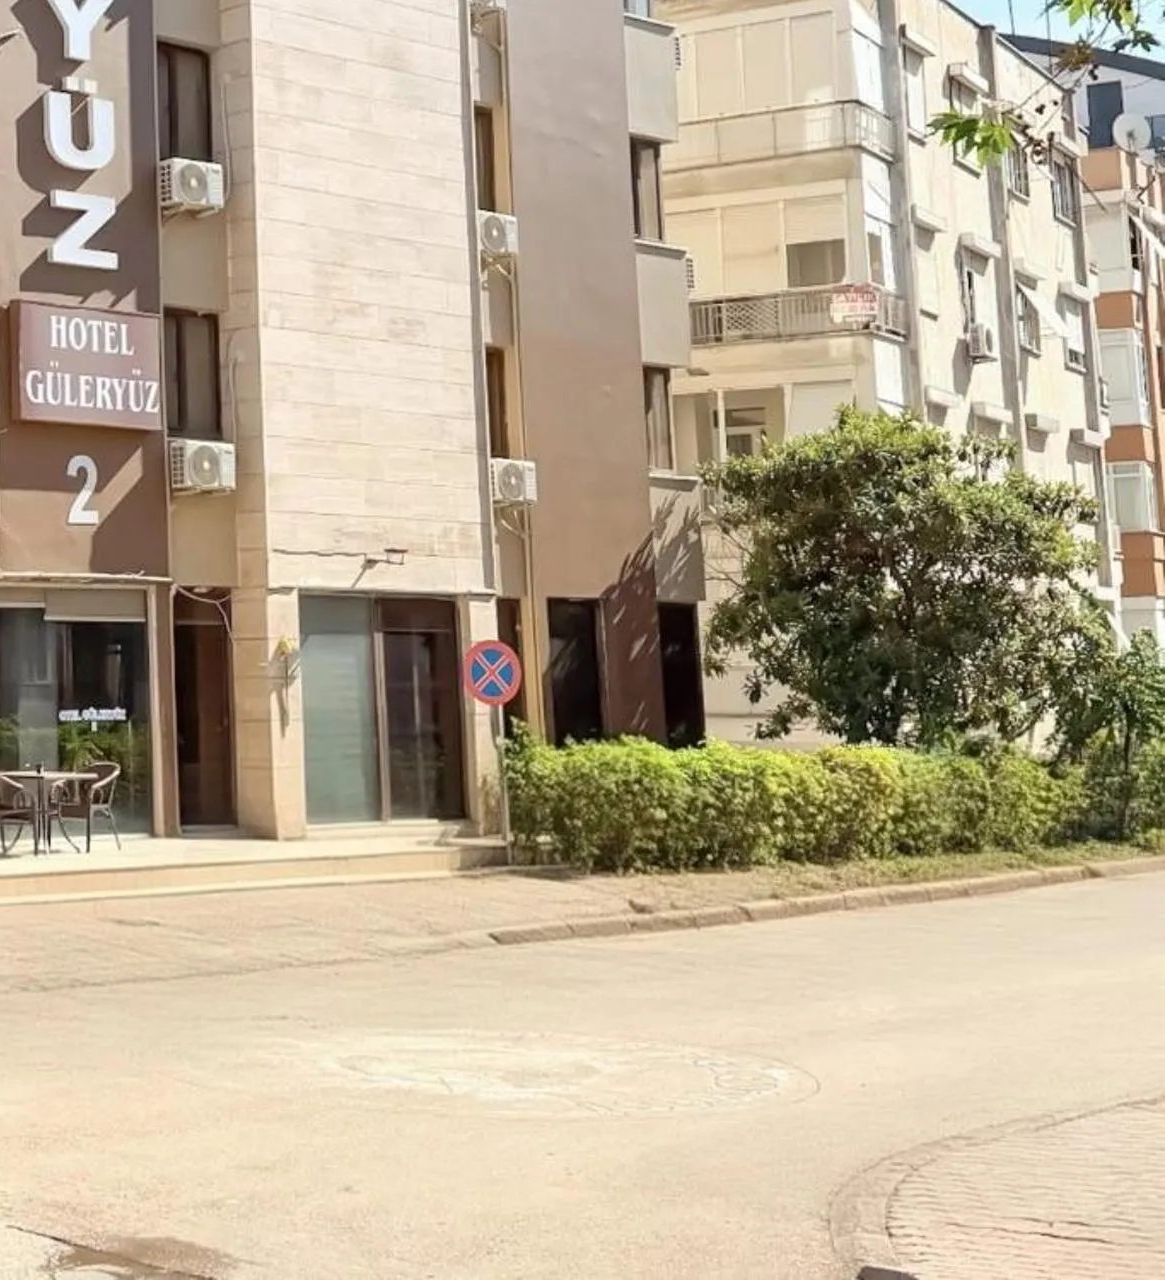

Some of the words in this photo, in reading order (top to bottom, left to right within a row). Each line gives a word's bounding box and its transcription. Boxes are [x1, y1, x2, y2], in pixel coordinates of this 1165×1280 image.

[49, 315, 135, 357] HOTEL
[25, 361, 161, 414] GÜLERYÜZ
[66, 454, 100, 526] 2
